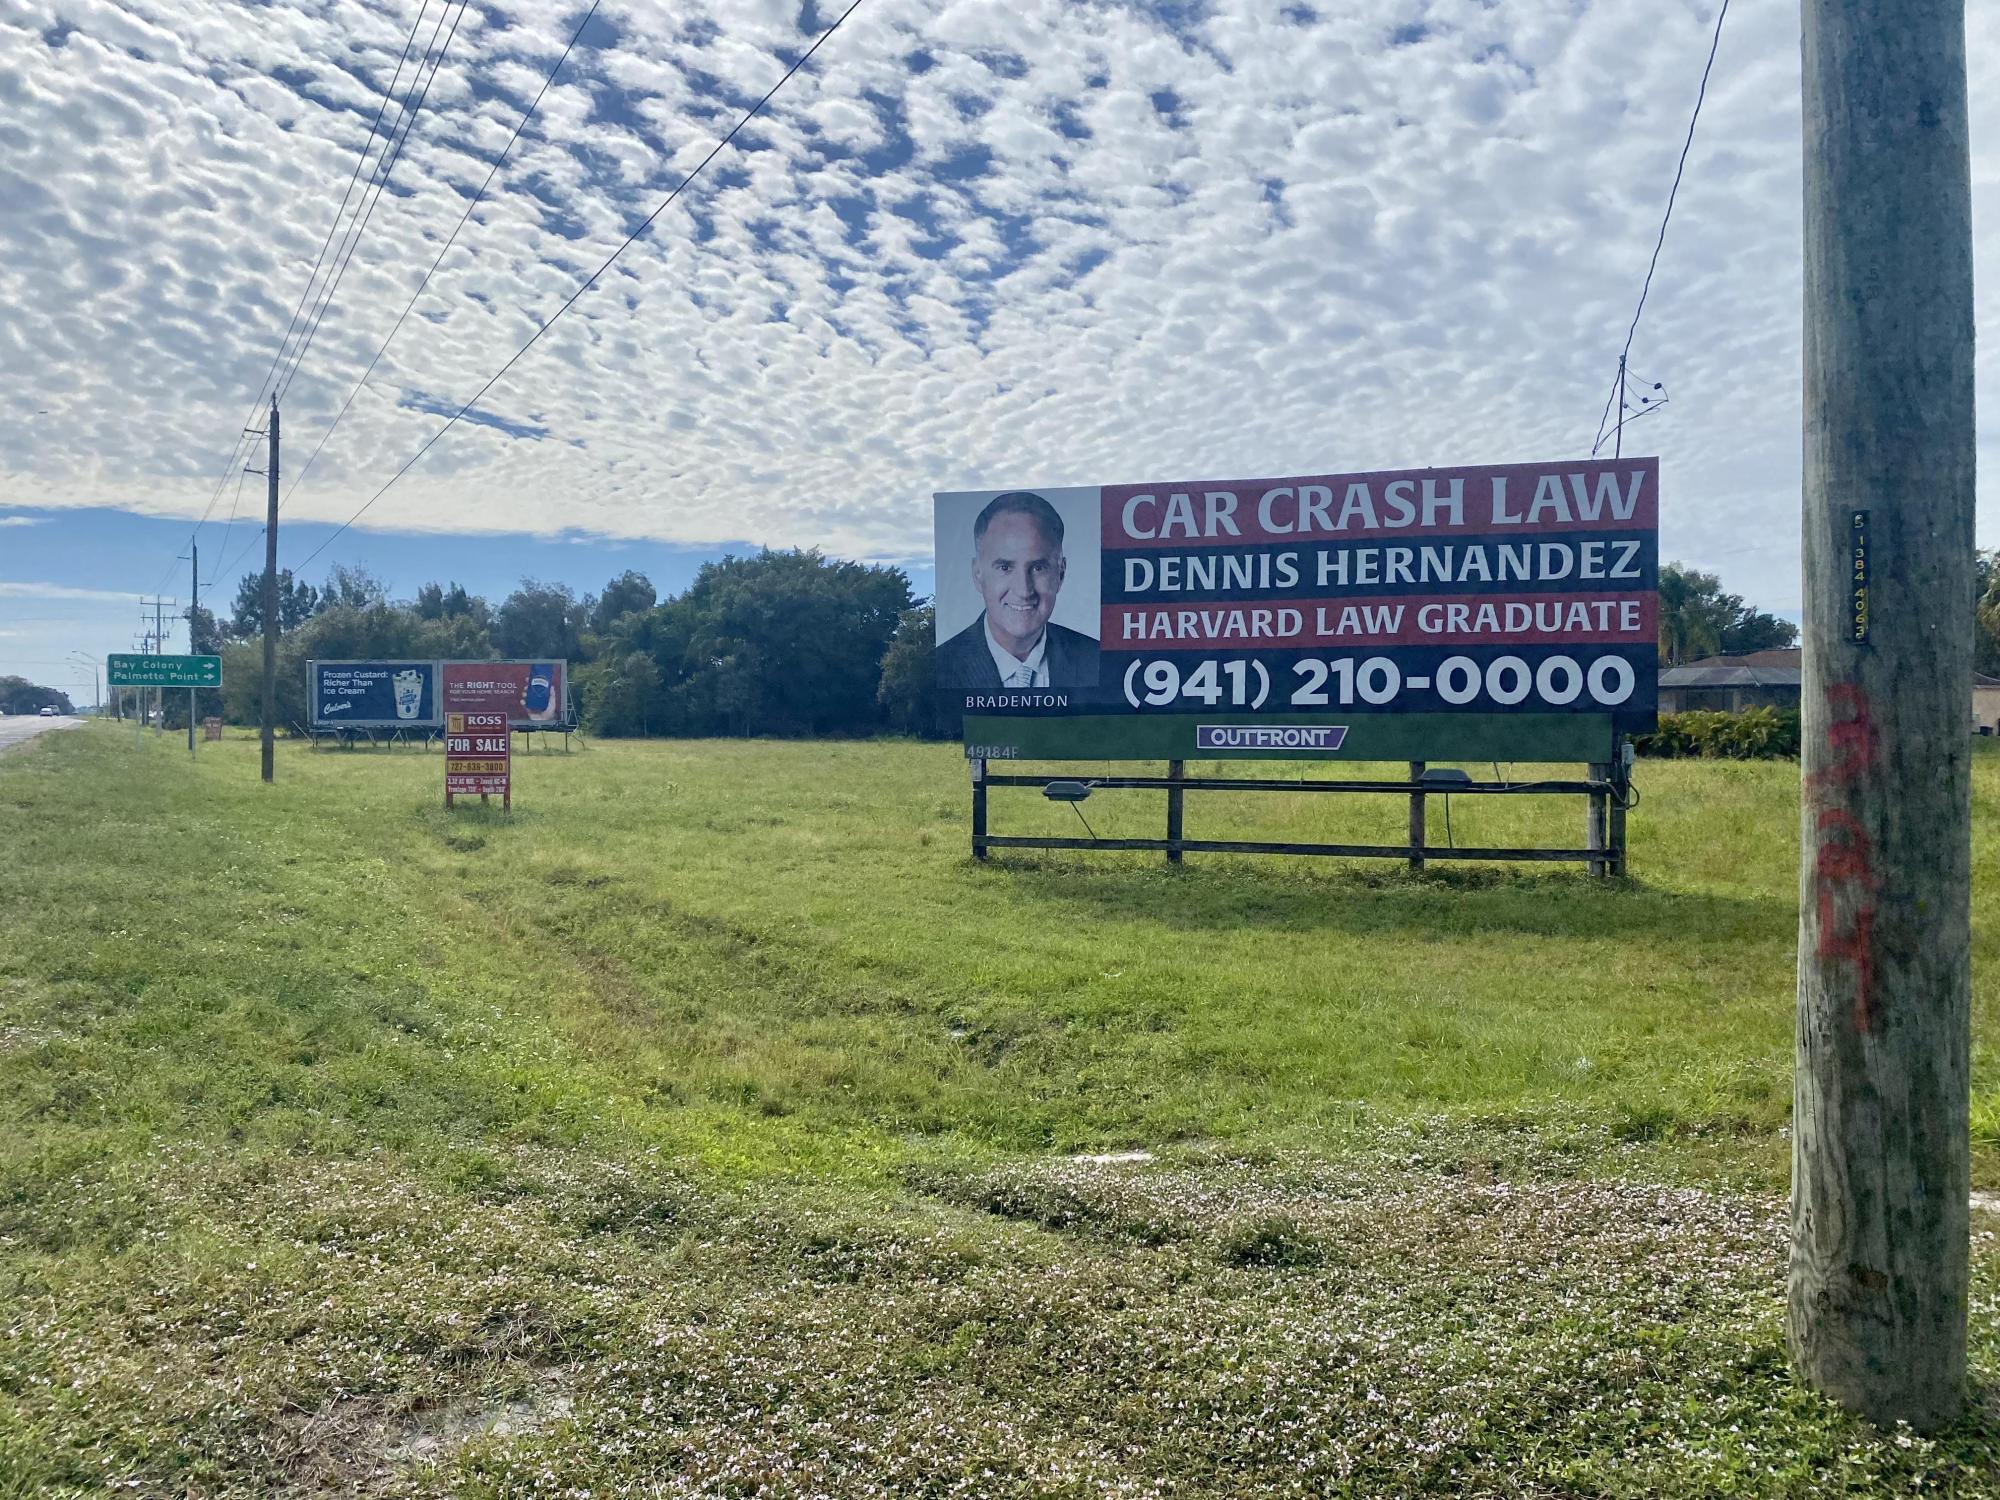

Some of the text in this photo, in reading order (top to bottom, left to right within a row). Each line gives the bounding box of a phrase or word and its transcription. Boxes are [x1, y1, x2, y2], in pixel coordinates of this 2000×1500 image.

[1121, 470, 1646, 540] CAR CRASH LAW
[1123, 540, 1642, 593] DENNIS HERNANDEZ
[1122, 600, 1642, 640] HARVARD LAW GRADUATE
[113, 660, 182, 670] Bay Colony
[113, 672, 199, 681] Palmetto Point
[353, 671, 389, 679] Custard:
[466, 681, 495, 689] RIGHT
[1123, 655, 1636, 711] (941) 210-0000
[965, 695, 1068, 708] BRADENTON
[468, 716, 502, 725] ROSS
[1210, 728, 1331, 746] OUTFRONT
[447, 738, 506, 752] FOR SALE
